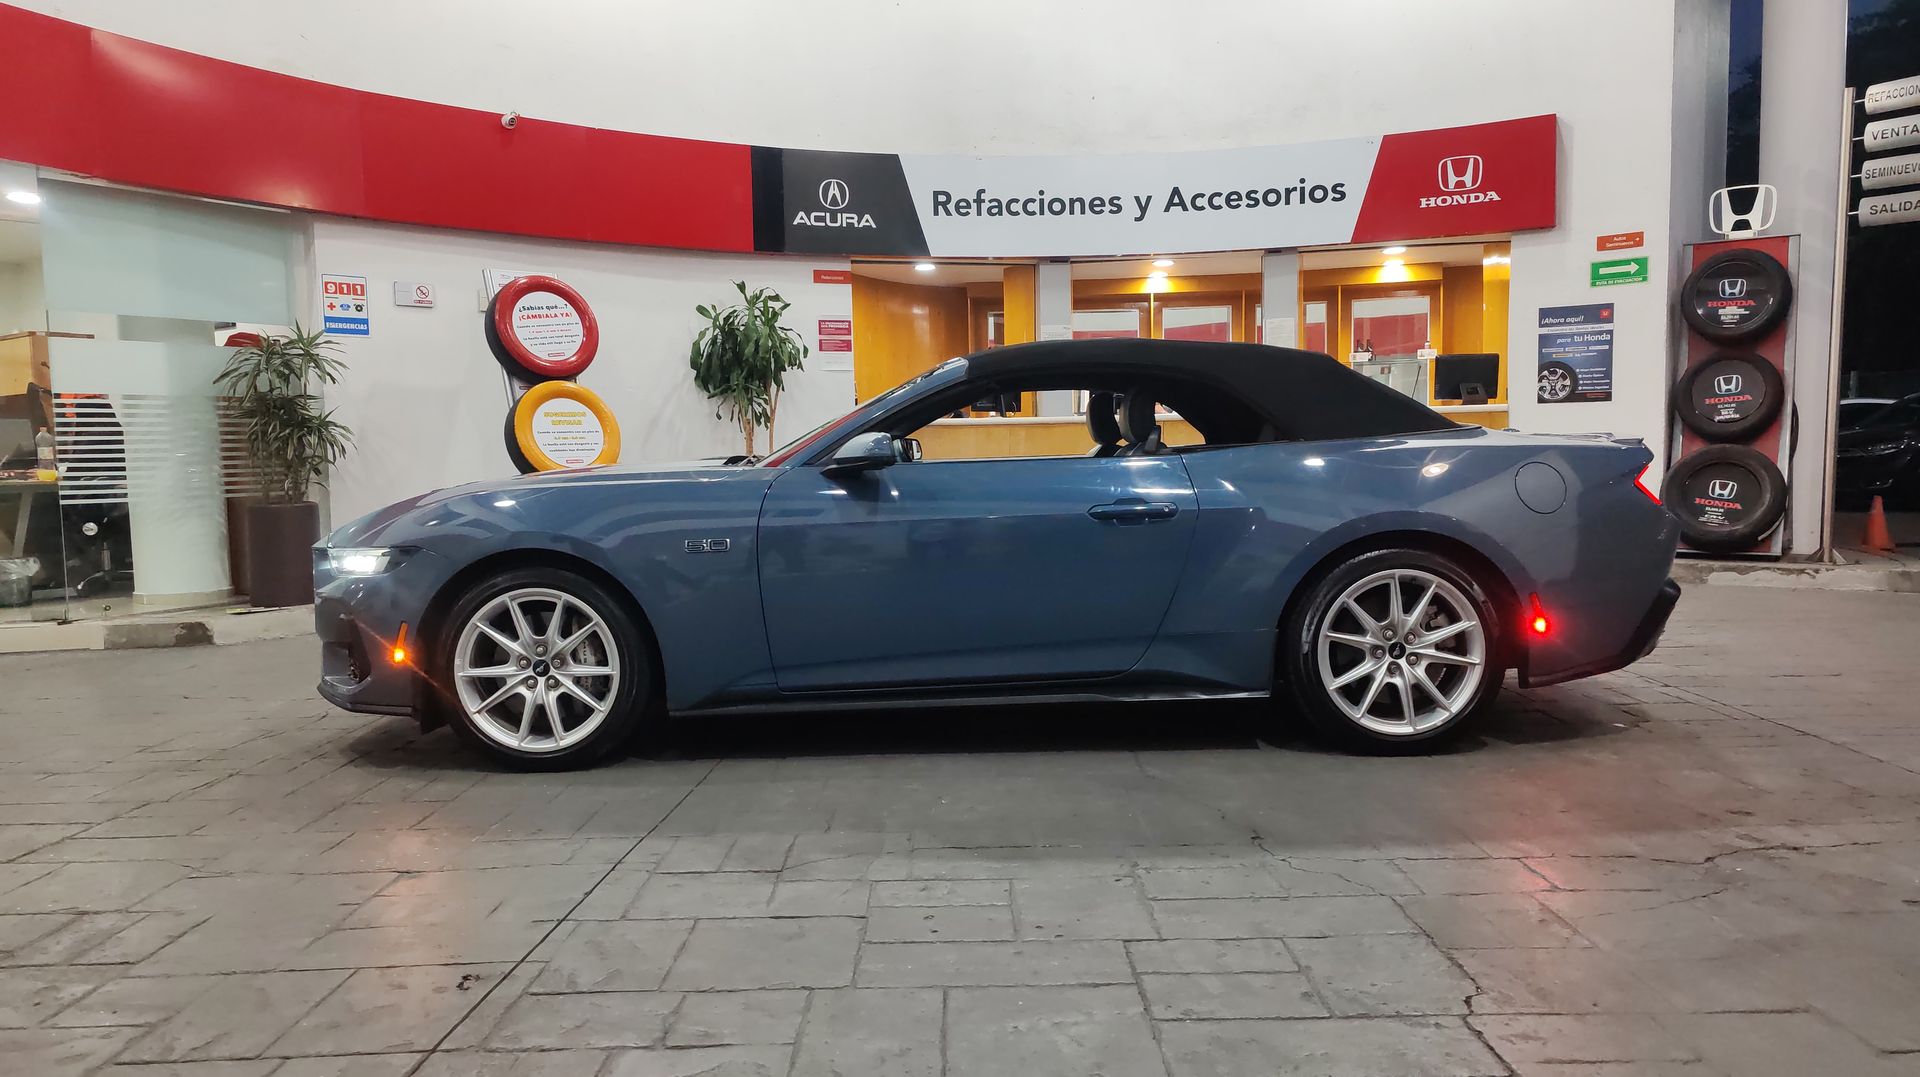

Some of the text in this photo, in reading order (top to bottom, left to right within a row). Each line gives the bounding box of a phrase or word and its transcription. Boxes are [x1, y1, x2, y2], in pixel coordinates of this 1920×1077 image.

[932, 178, 1347, 222] Refacciones y Accesorios
[1419, 191, 1502, 208] HONDA
[792, 211, 877, 229] ACURA
[325, 282, 364, 296] 911
[326, 321, 368, 330] EMERGENCIAS
[1584, 333, 1611, 342] Honda
[1704, 395, 1753, 404] HONDA
[1695, 498, 1742, 509] HONDA
